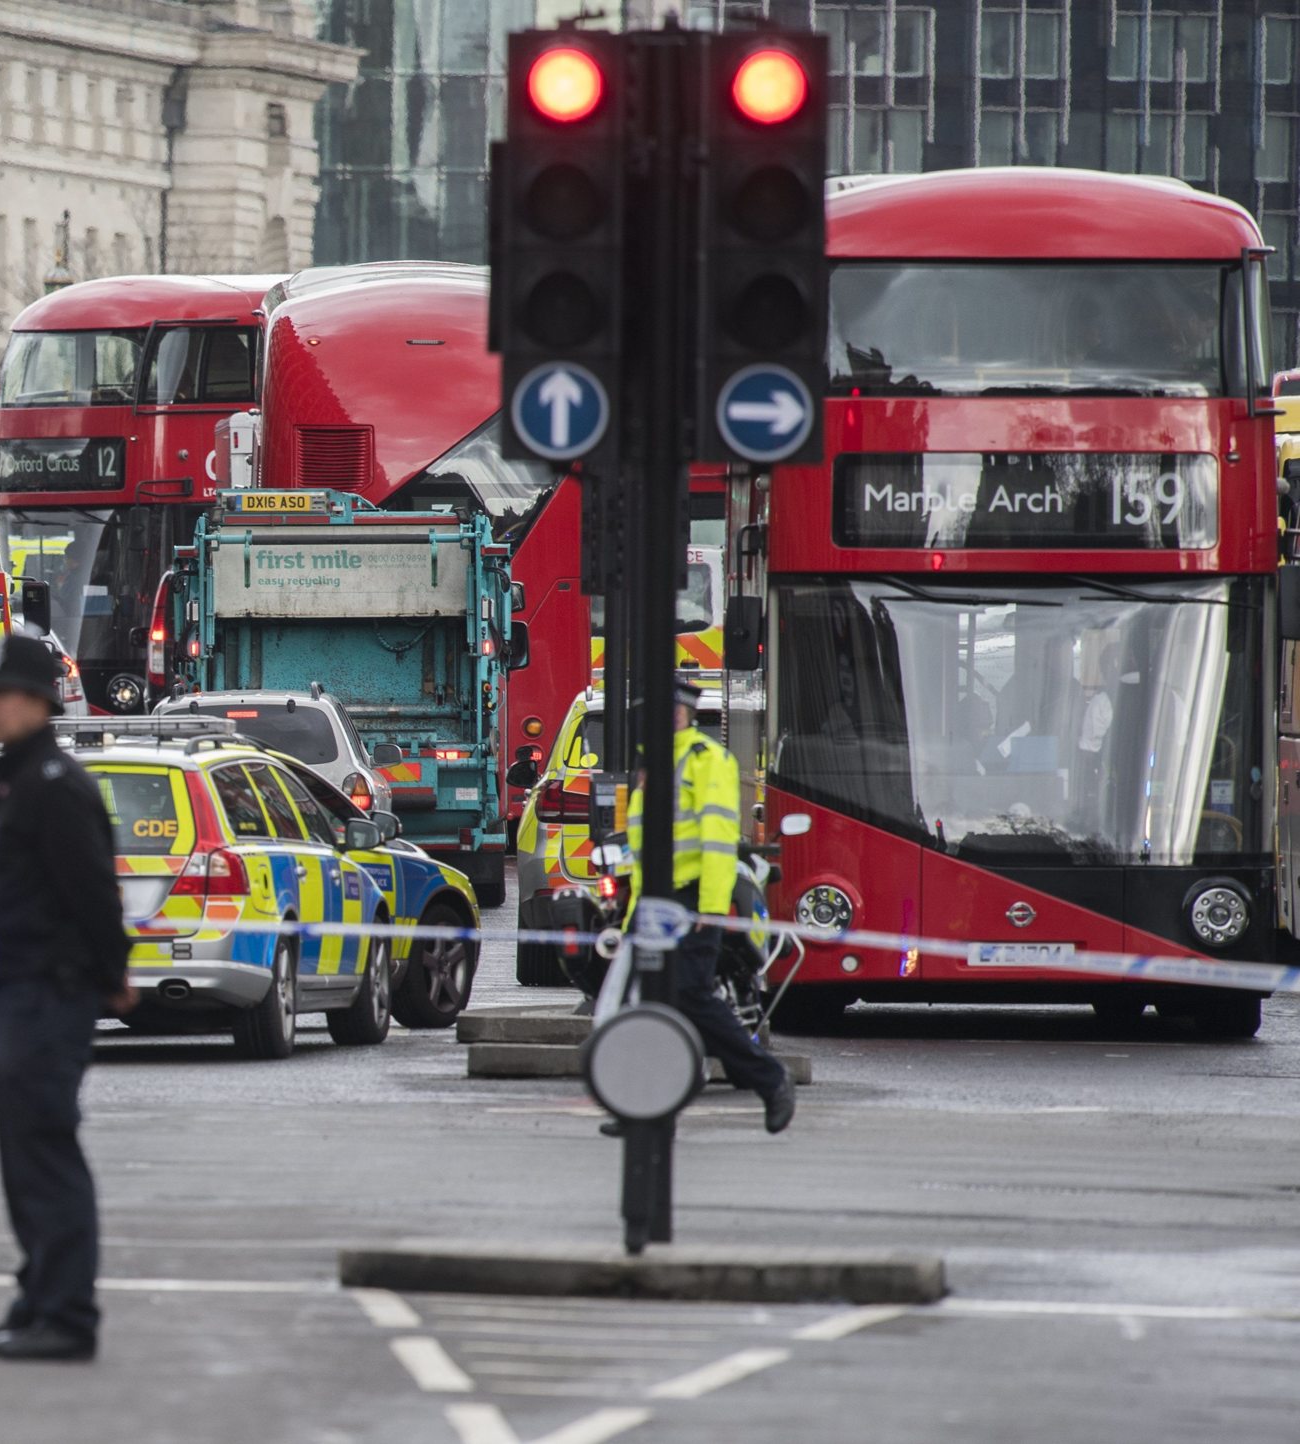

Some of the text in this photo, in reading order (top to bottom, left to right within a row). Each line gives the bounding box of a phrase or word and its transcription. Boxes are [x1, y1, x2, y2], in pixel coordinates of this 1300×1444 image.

[6, 446, 116, 477] Oxford Circus 12
[247, 496, 276, 509] DX16
[864, 472, 1186, 525] Marble Arch 159
[255, 549, 363, 570] first mile
[258, 576, 341, 588] easy recycling
[133, 819, 178, 838] CDE
